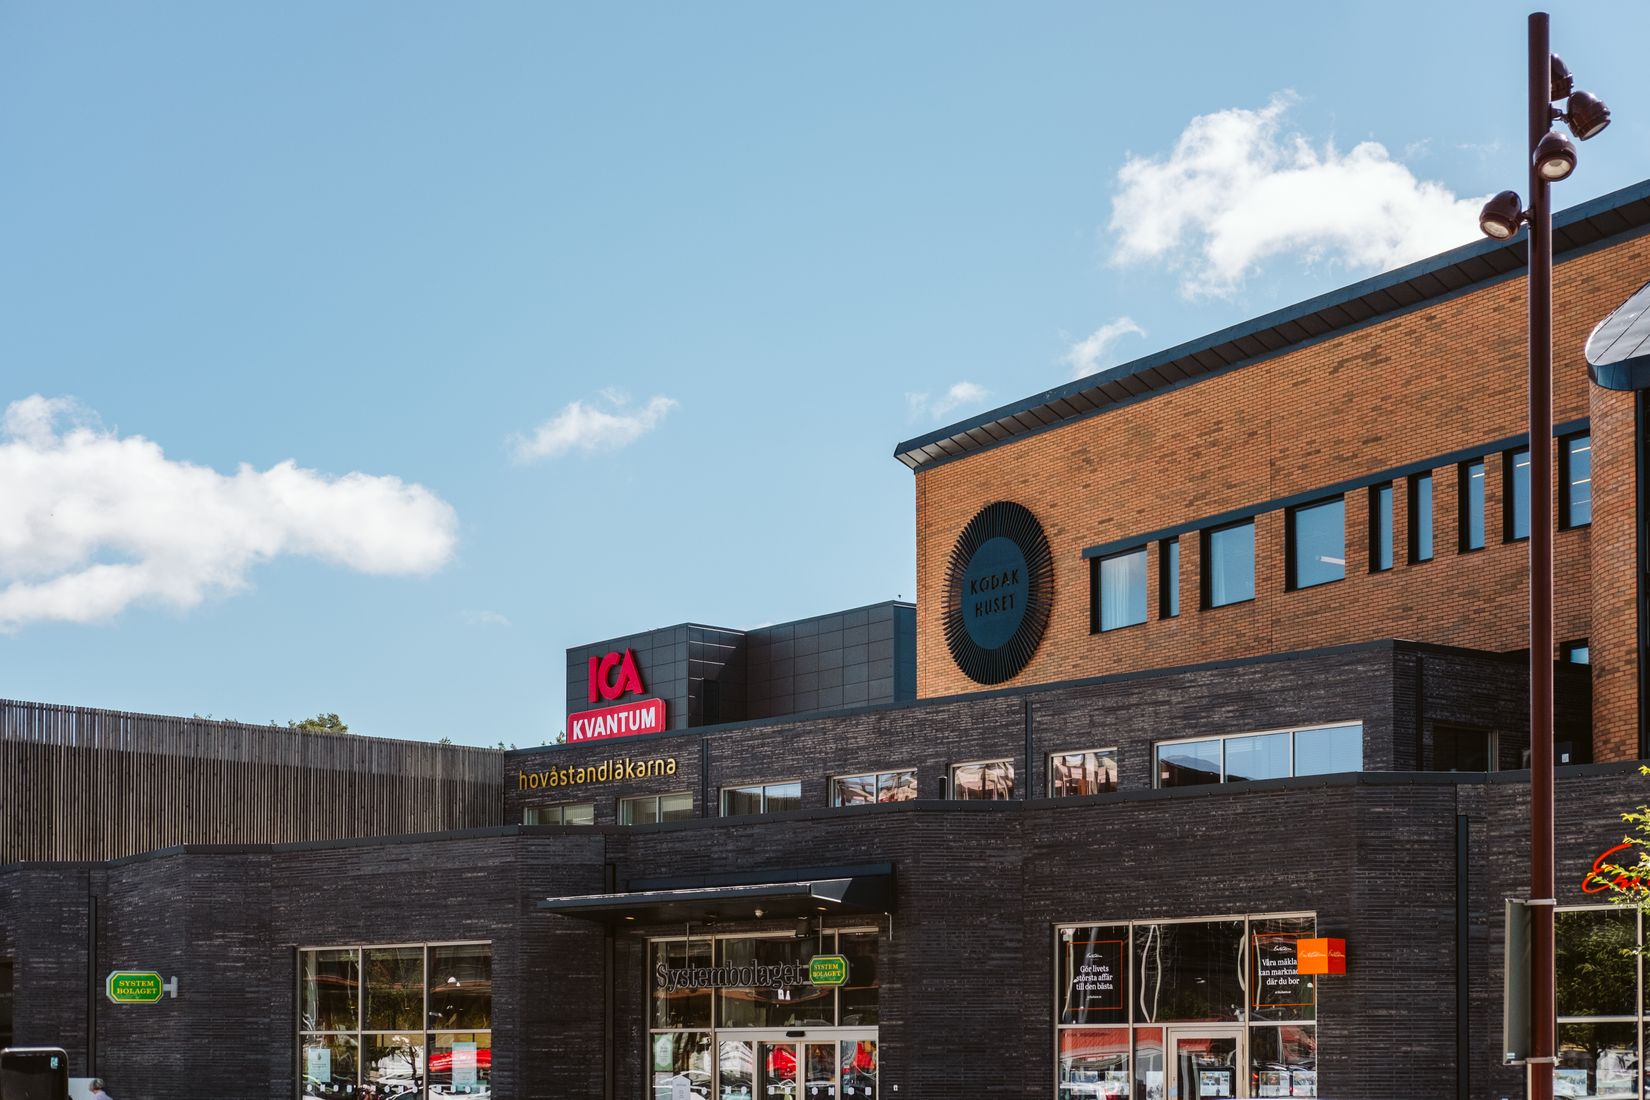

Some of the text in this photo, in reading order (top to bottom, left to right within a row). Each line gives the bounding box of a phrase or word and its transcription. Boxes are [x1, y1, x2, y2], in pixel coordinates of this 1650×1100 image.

[970, 569, 1018, 596] KODAK
[975, 593, 1016, 618] HUSET
[588, 647, 646, 703] ICA
[572, 706, 656, 740] KVANTUM
[518, 757, 677, 791] hovåstandläkarna
[1080, 964, 1109, 973] Gör livets
[1262, 957, 1297, 966] Våra mäkla
[656, 959, 803, 992] Systembolaget
[1076, 973, 1113, 982] största affär
[1076, 982, 1084, 990] till
[1097, 982, 1113, 990] bästa
[1266, 977, 1300, 986] där du bor
